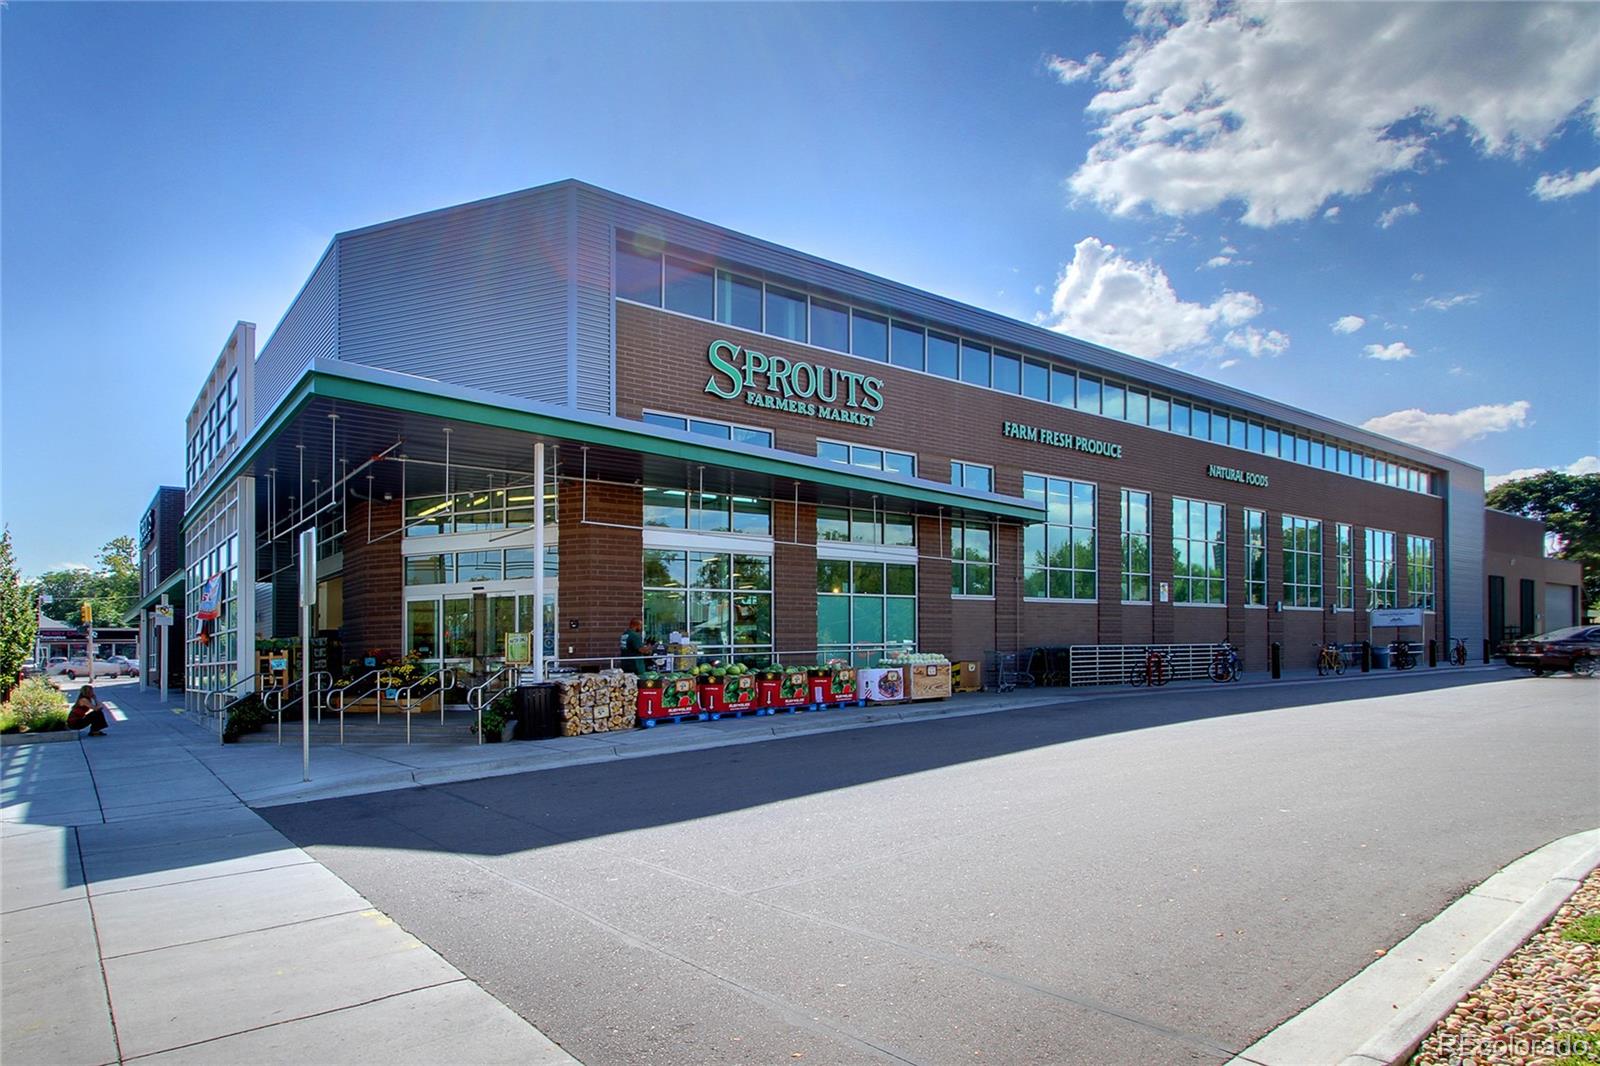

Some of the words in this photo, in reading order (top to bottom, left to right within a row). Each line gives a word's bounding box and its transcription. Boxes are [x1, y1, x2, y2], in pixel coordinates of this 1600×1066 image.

[704, 339, 884, 412] SPROUTS
[746, 391, 815, 416] FARMERS
[818, 405, 876, 427] MARKET
[1003, 421, 1037, 442] FARM
[1039, 429, 1073, 449] FRESH
[1075, 436, 1122, 459] PRODUCE
[1208, 464, 1244, 483] NATURAL
[1245, 471, 1269, 487] FOODS
